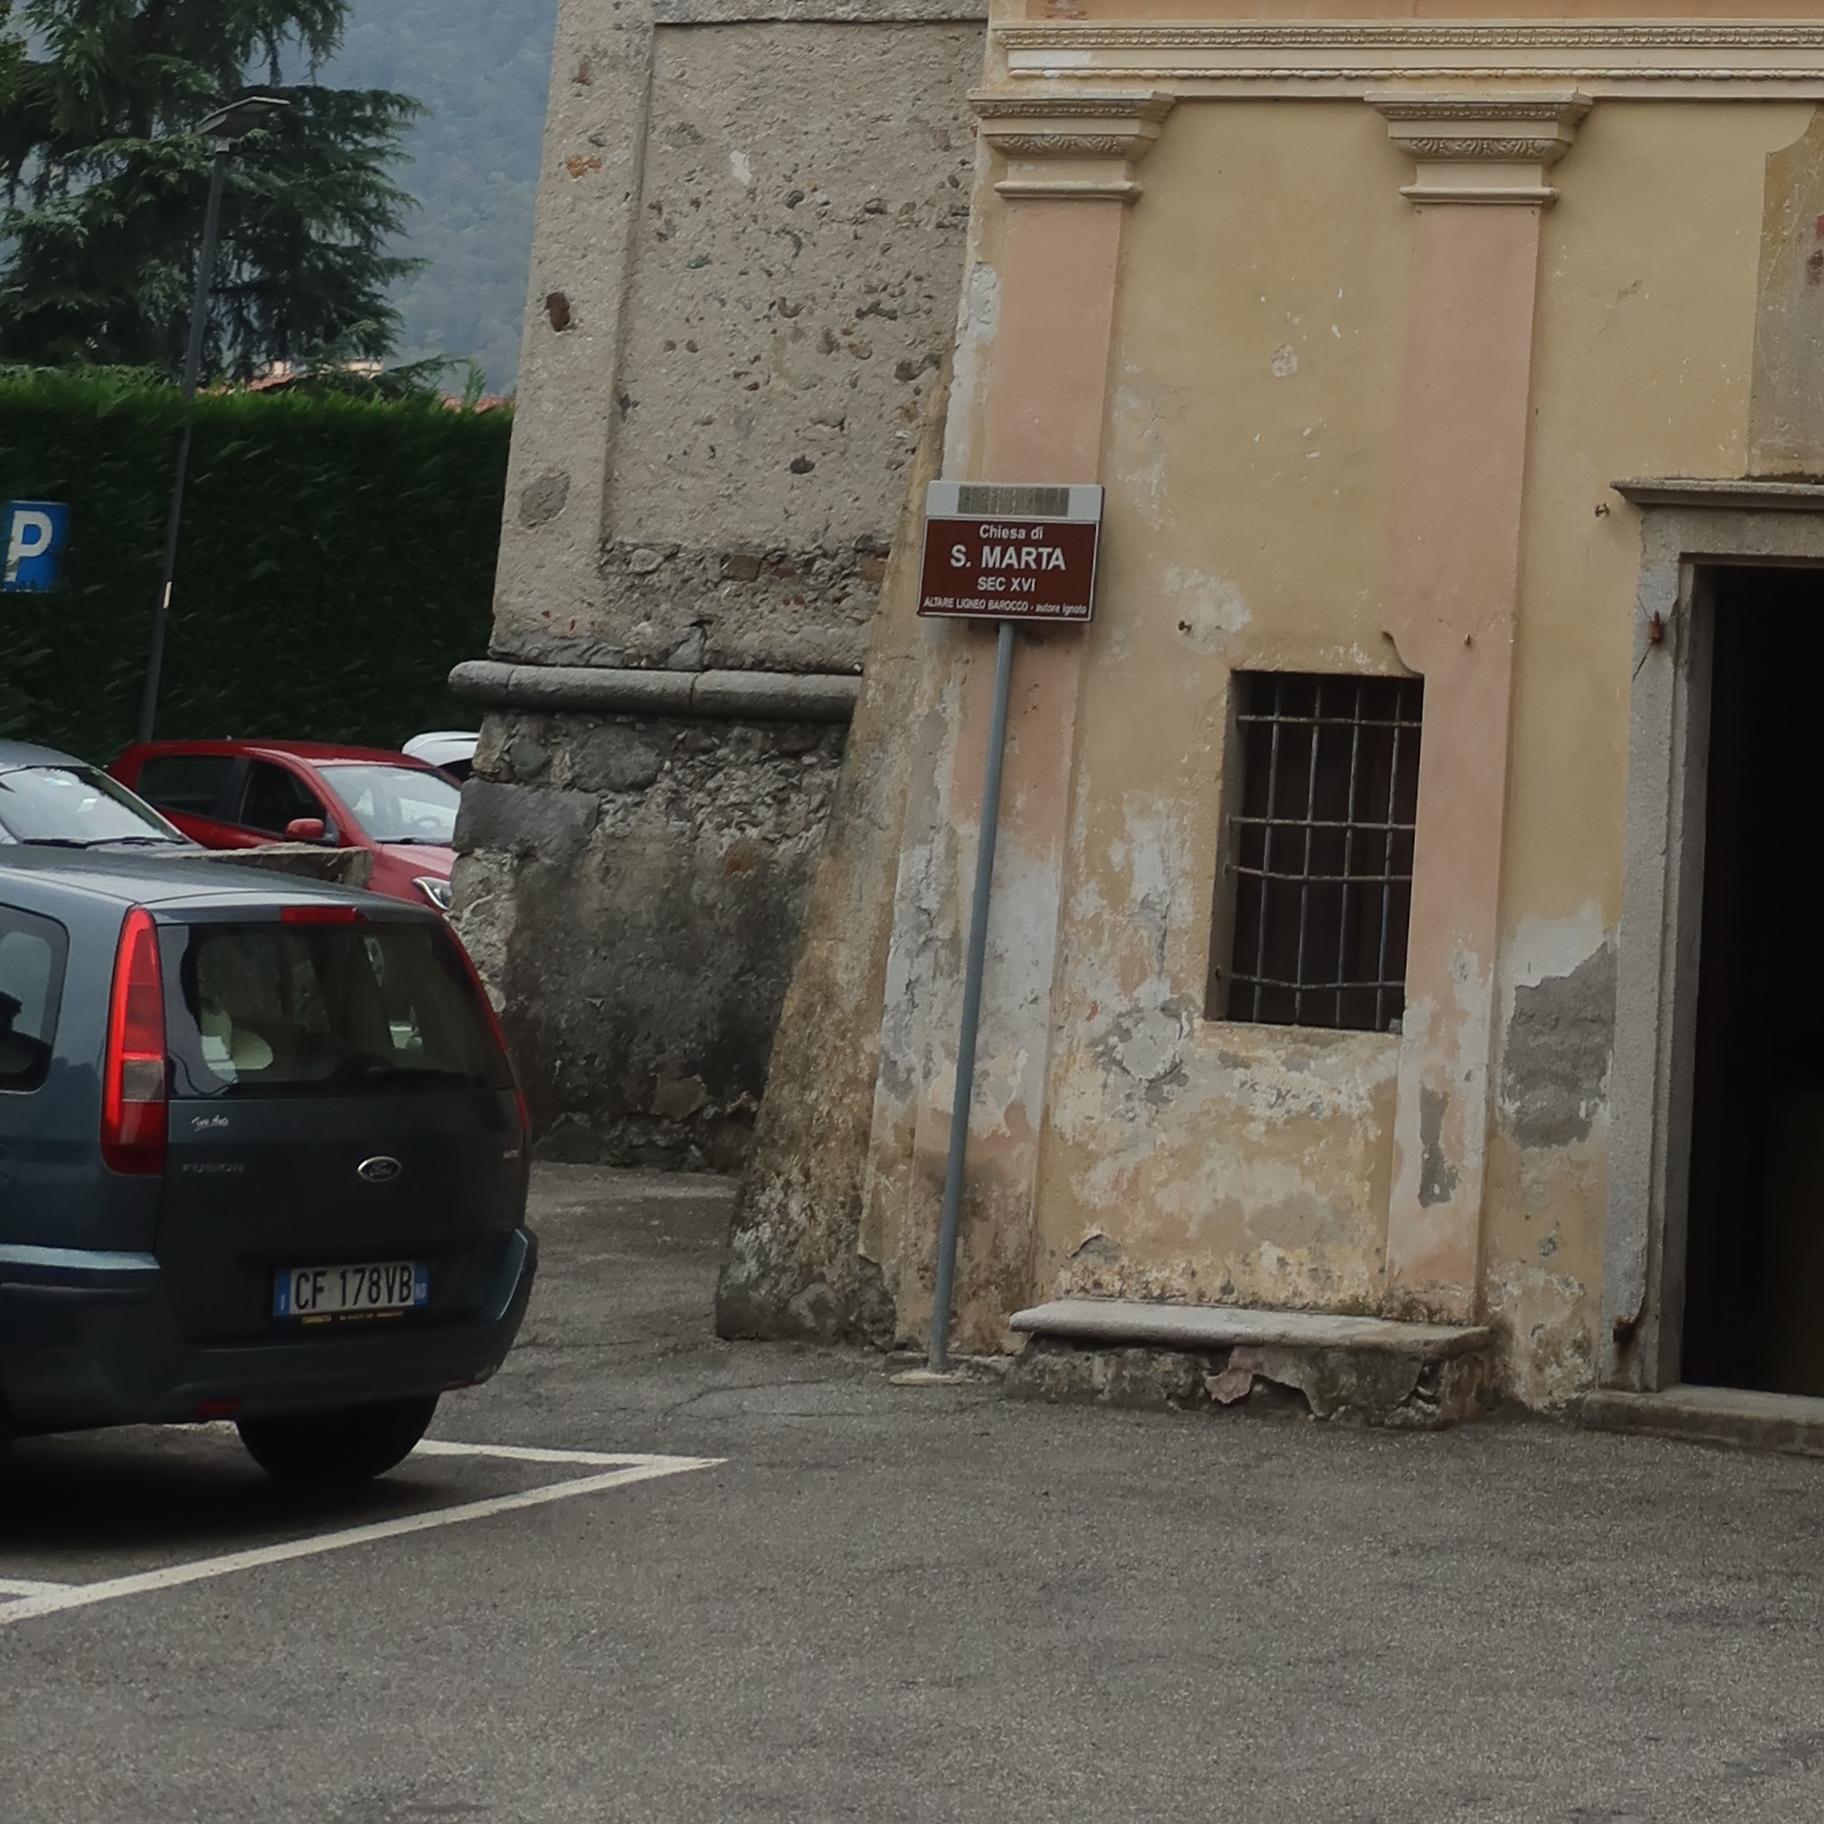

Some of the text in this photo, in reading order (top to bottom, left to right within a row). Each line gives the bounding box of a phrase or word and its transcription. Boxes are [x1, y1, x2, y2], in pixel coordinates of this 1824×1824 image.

[979, 523, 1043, 540] Chiesa di
[4, 509, 54, 583] P
[950, 544, 1066, 571] S. MARTA
[977, 576, 1036, 592] SEC XVI
[923, 596, 955, 608] ALTARE
[956, 598, 986, 610] LIGNEO
[987, 599, 1028, 612] BAROCCO
[295, 1270, 327, 1310] CF
[340, 1264, 412, 1308] 178VB
